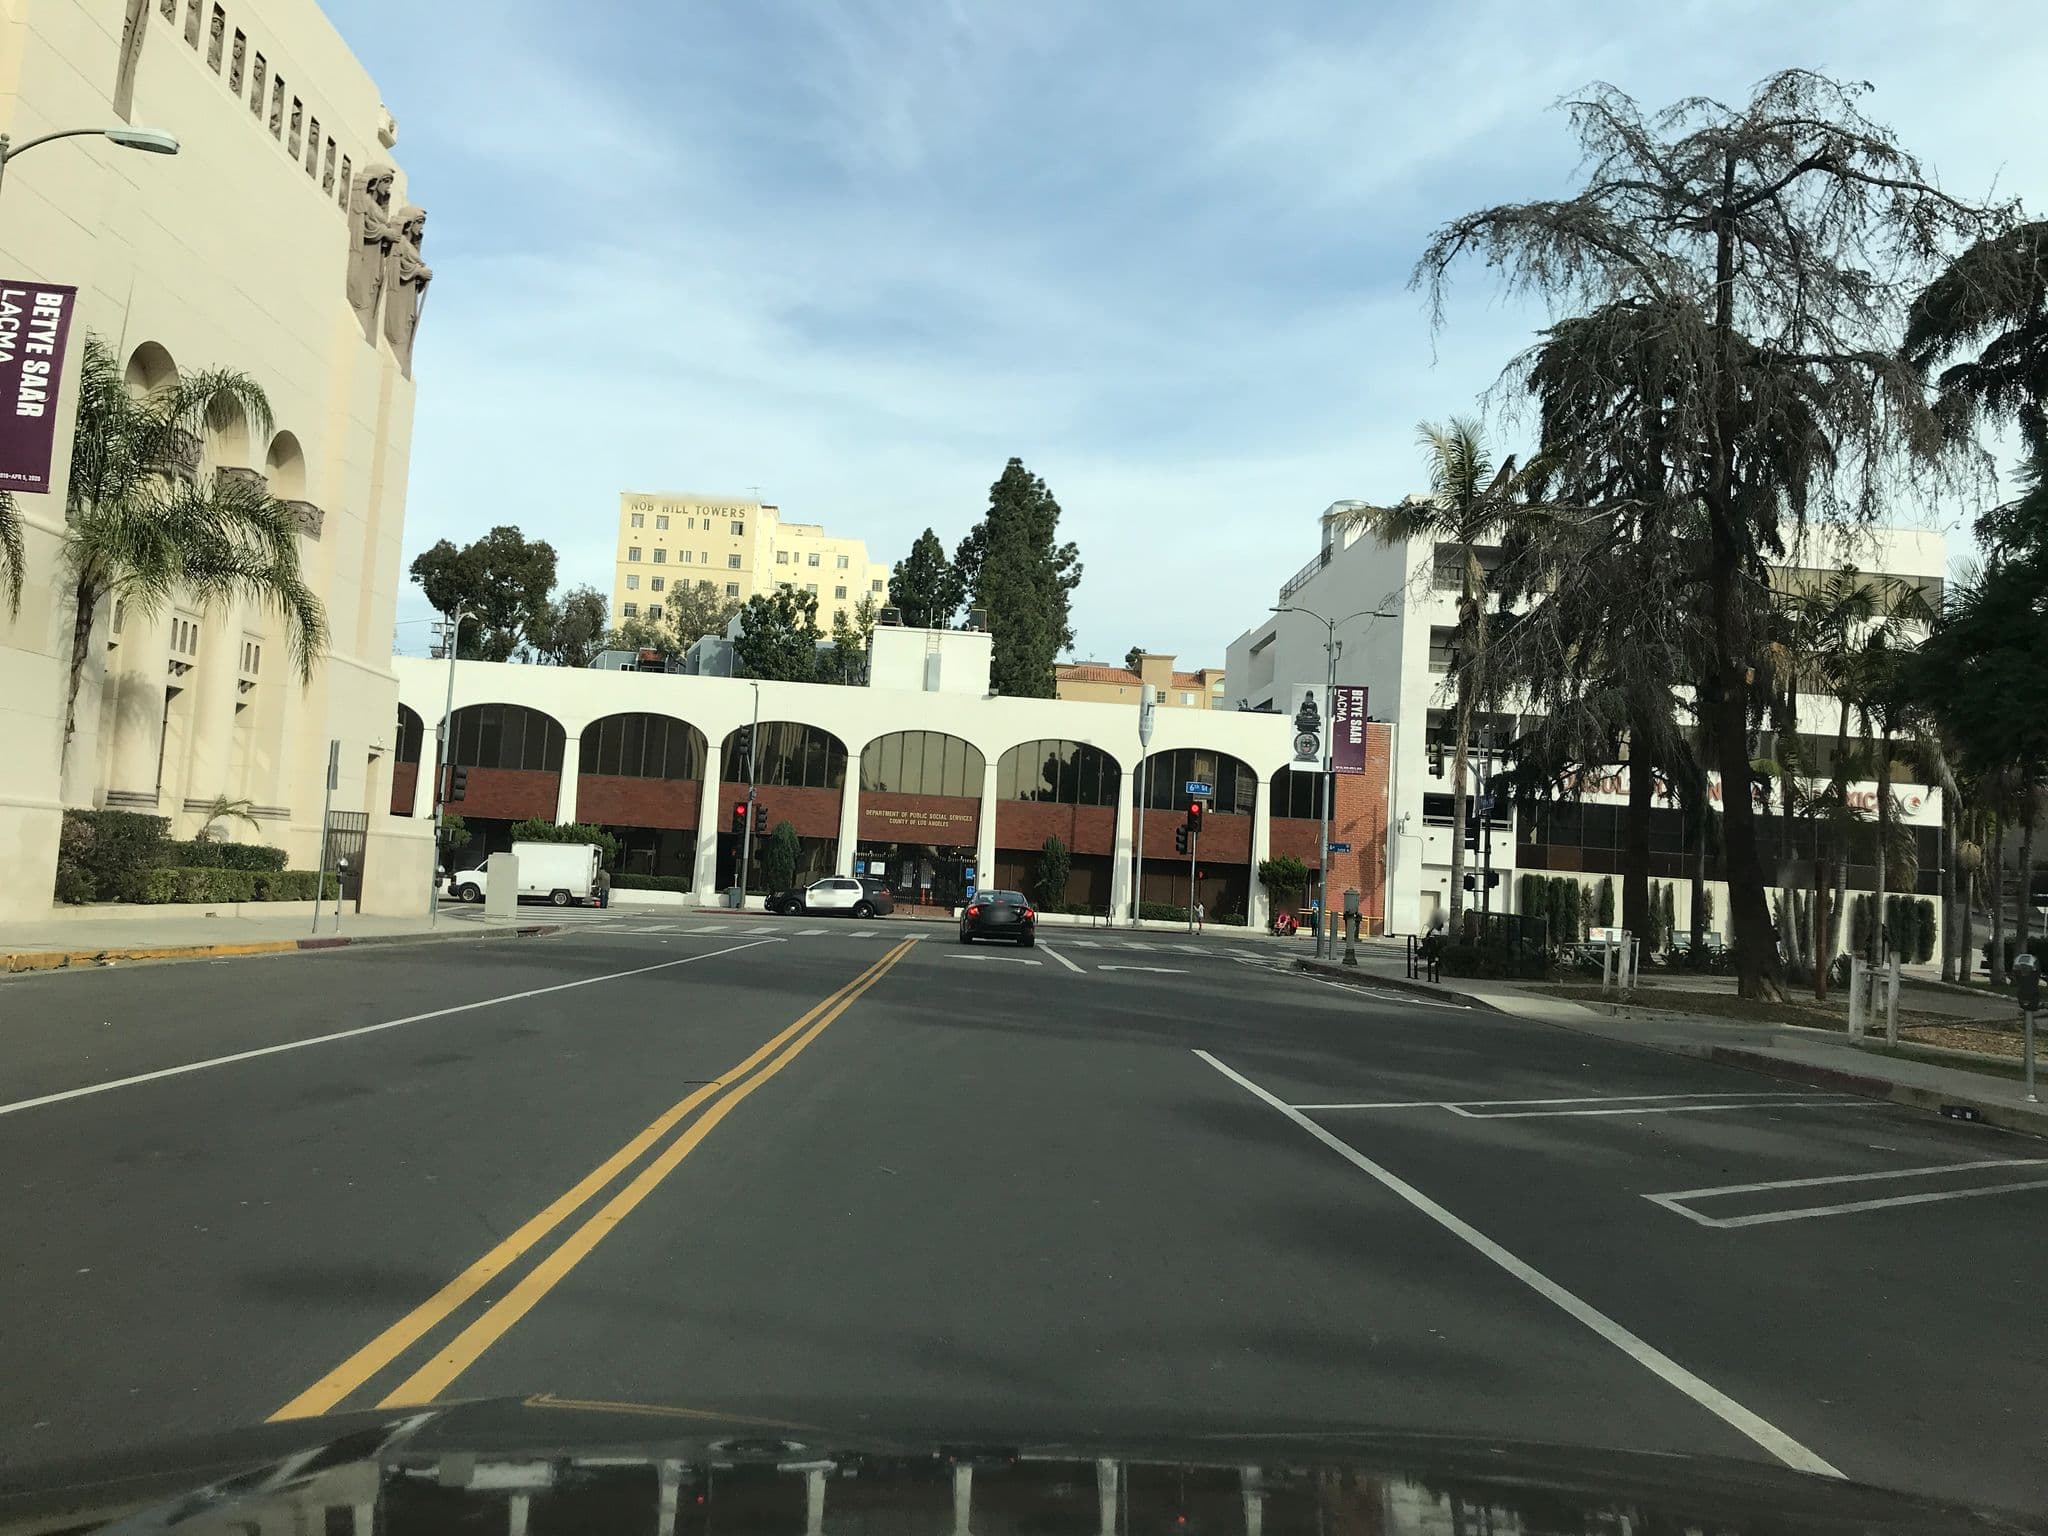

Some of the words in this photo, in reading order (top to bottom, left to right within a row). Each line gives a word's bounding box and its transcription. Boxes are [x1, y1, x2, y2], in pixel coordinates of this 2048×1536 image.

[0, 289, 26, 363] LACMA
[25, 292, 63, 355] BETYE
[16, 359, 51, 417] SAAR
[631, 501, 654, 512] NOB
[662, 504, 689, 514] HILL
[695, 505, 746, 518] TOWERS
[1336, 689, 1348, 723] LACMA
[1350, 689, 1364, 718] BETYE
[1349, 719, 1363, 744] SAAR
